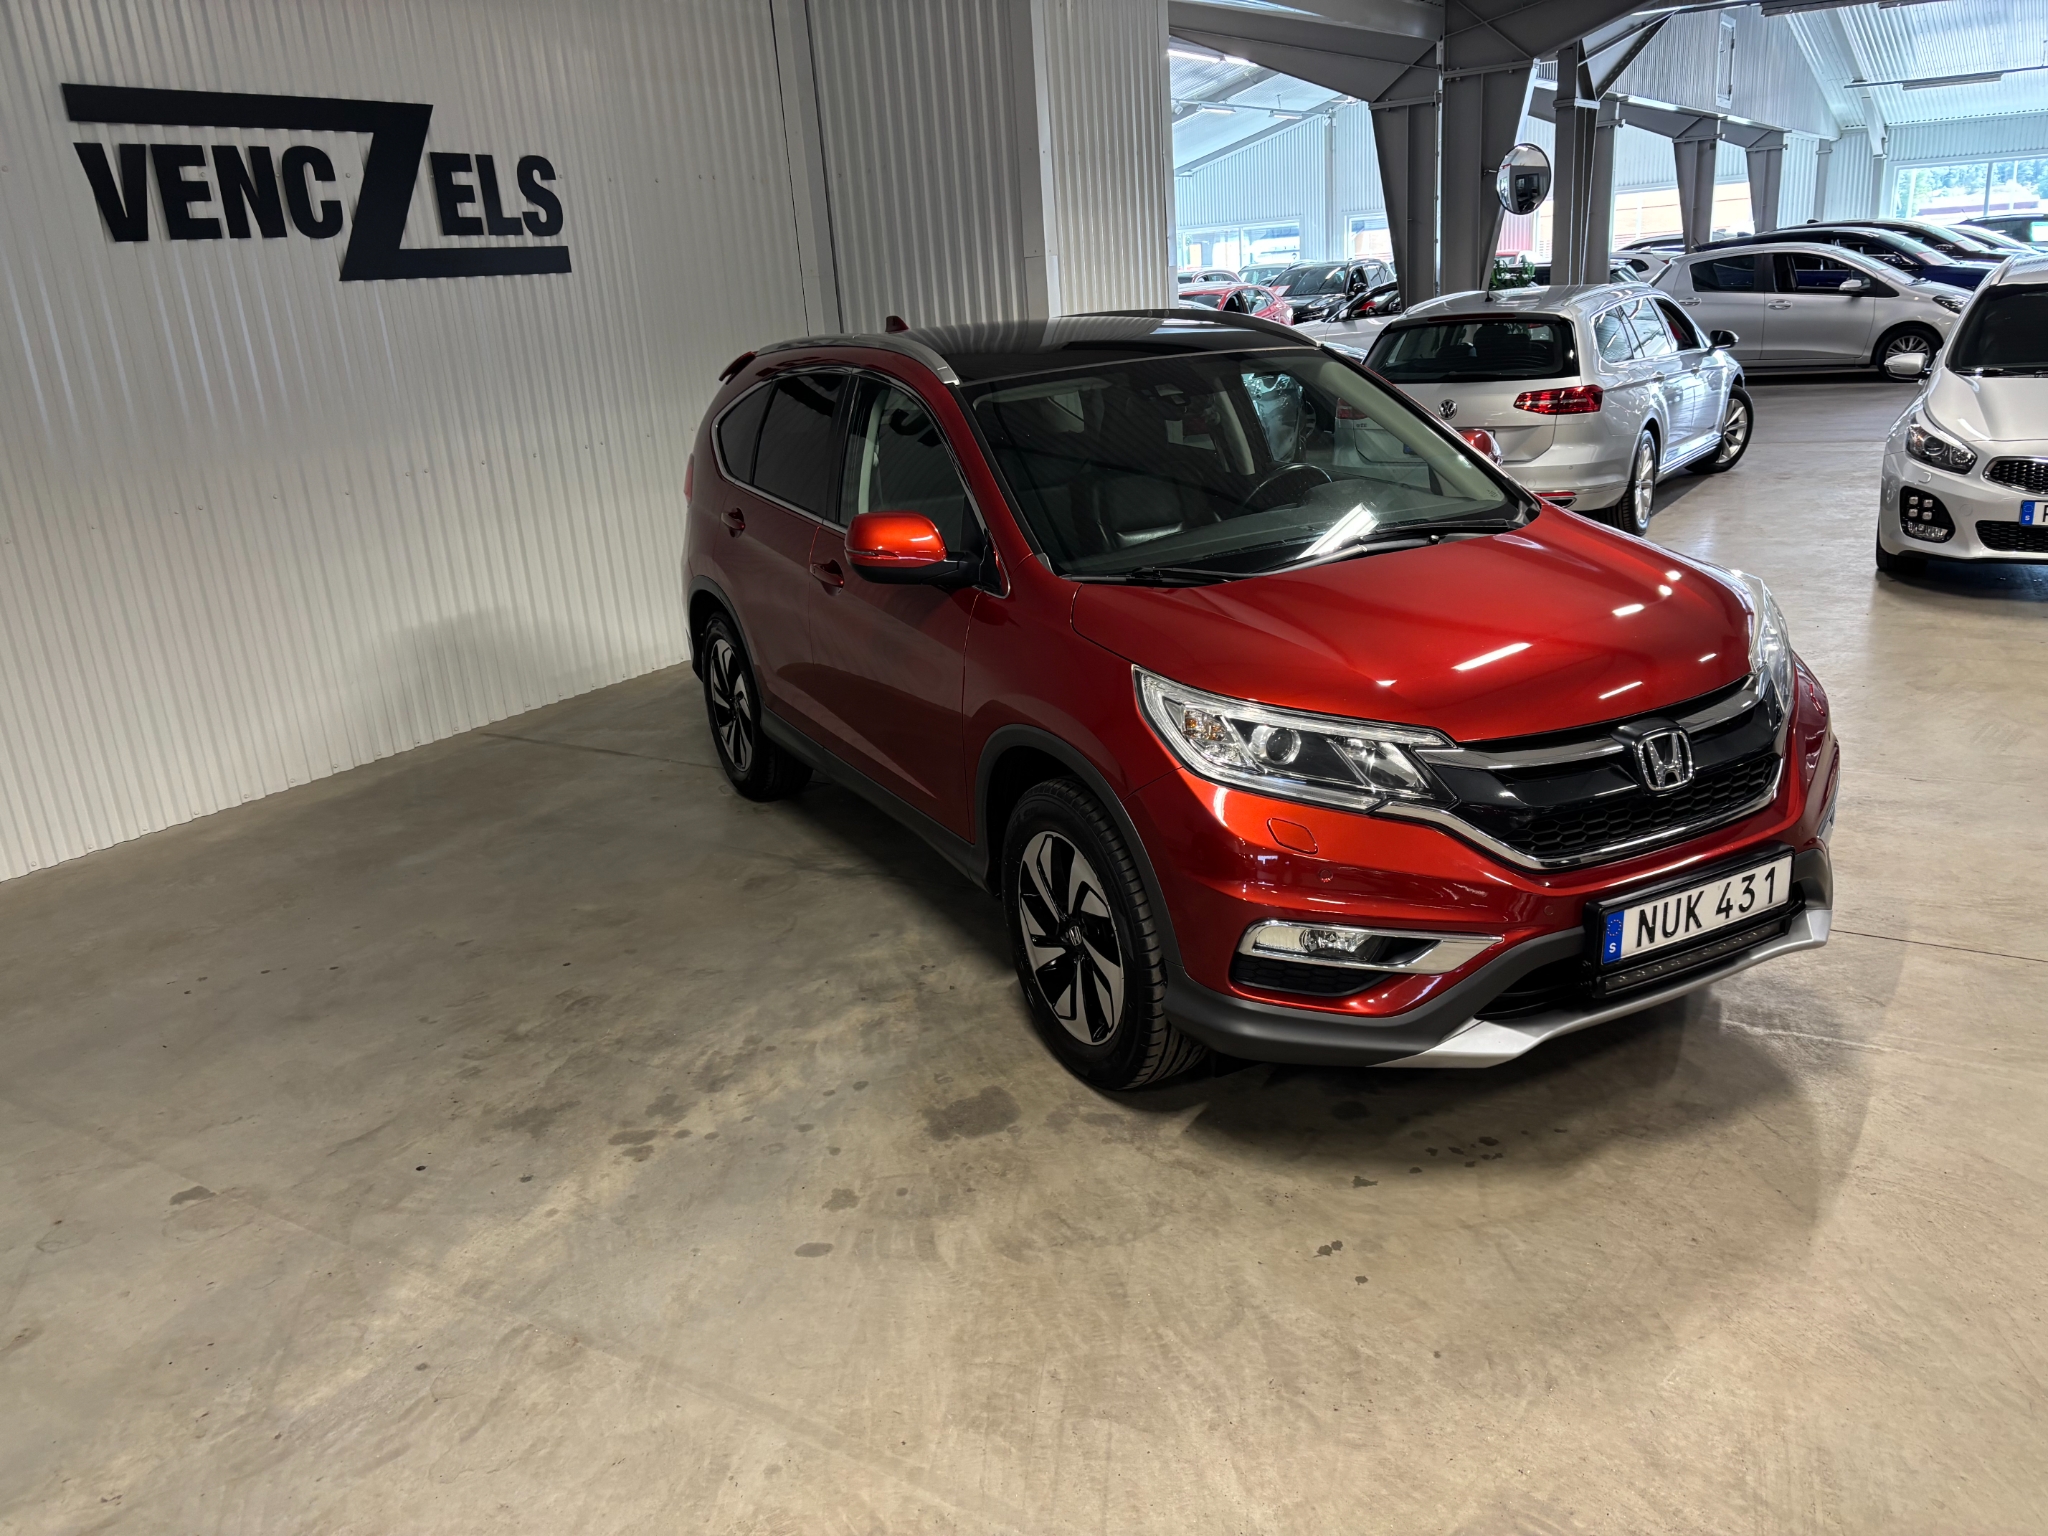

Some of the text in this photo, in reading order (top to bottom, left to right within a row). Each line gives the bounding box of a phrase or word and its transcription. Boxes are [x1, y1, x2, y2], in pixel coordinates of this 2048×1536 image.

[61, 83, 572, 281] VENCZELS
[1608, 866, 1776, 954] S NUK 431
